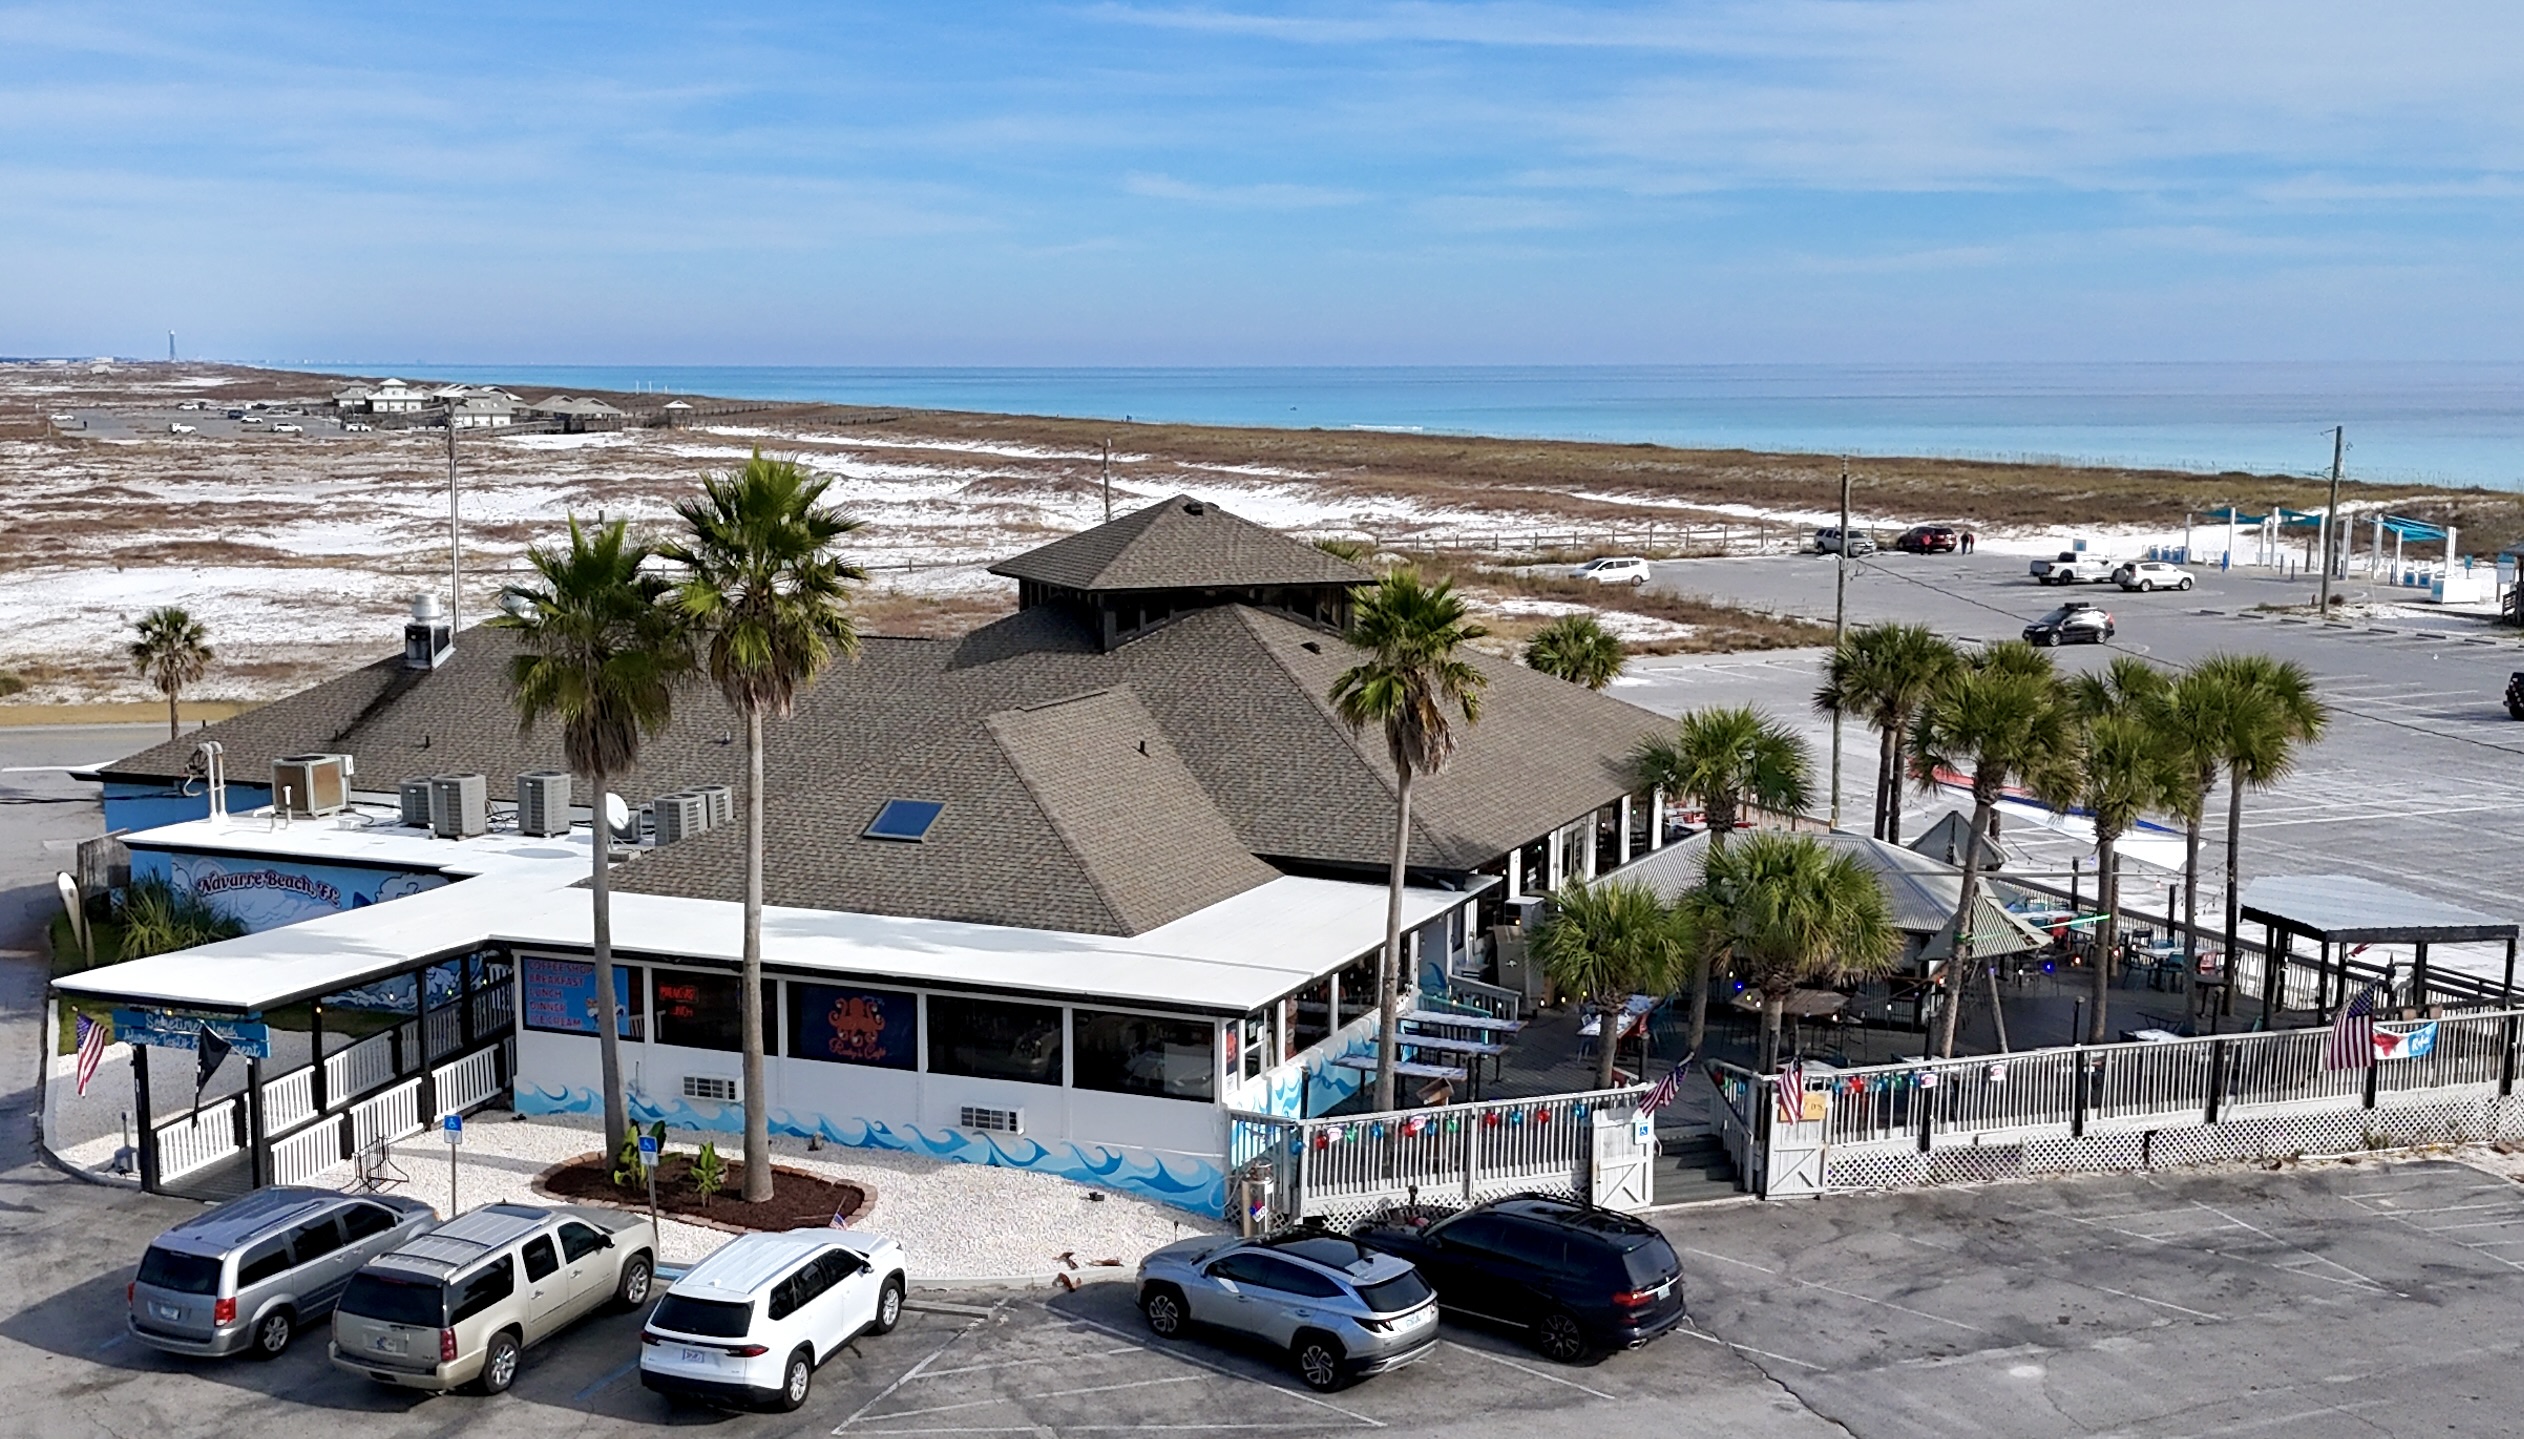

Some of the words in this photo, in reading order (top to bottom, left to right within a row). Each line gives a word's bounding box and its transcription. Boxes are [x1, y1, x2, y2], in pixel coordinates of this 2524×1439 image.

[198, 870, 263, 896] Navarre
[264, 869, 317, 899] Beach,
[316, 880, 341, 908] FL
[527, 960, 565, 972] COFFEE
[567, 964, 593, 974] SHOP
[528, 973, 583, 987] BREAKFAST
[529, 988, 562, 999] LUNCH
[530, 1001, 566, 1012] DINNER
[530, 1014, 545, 1024] ICE
[547, 1016, 582, 1028] CREAM
[123, 1028, 159, 1045] Always
